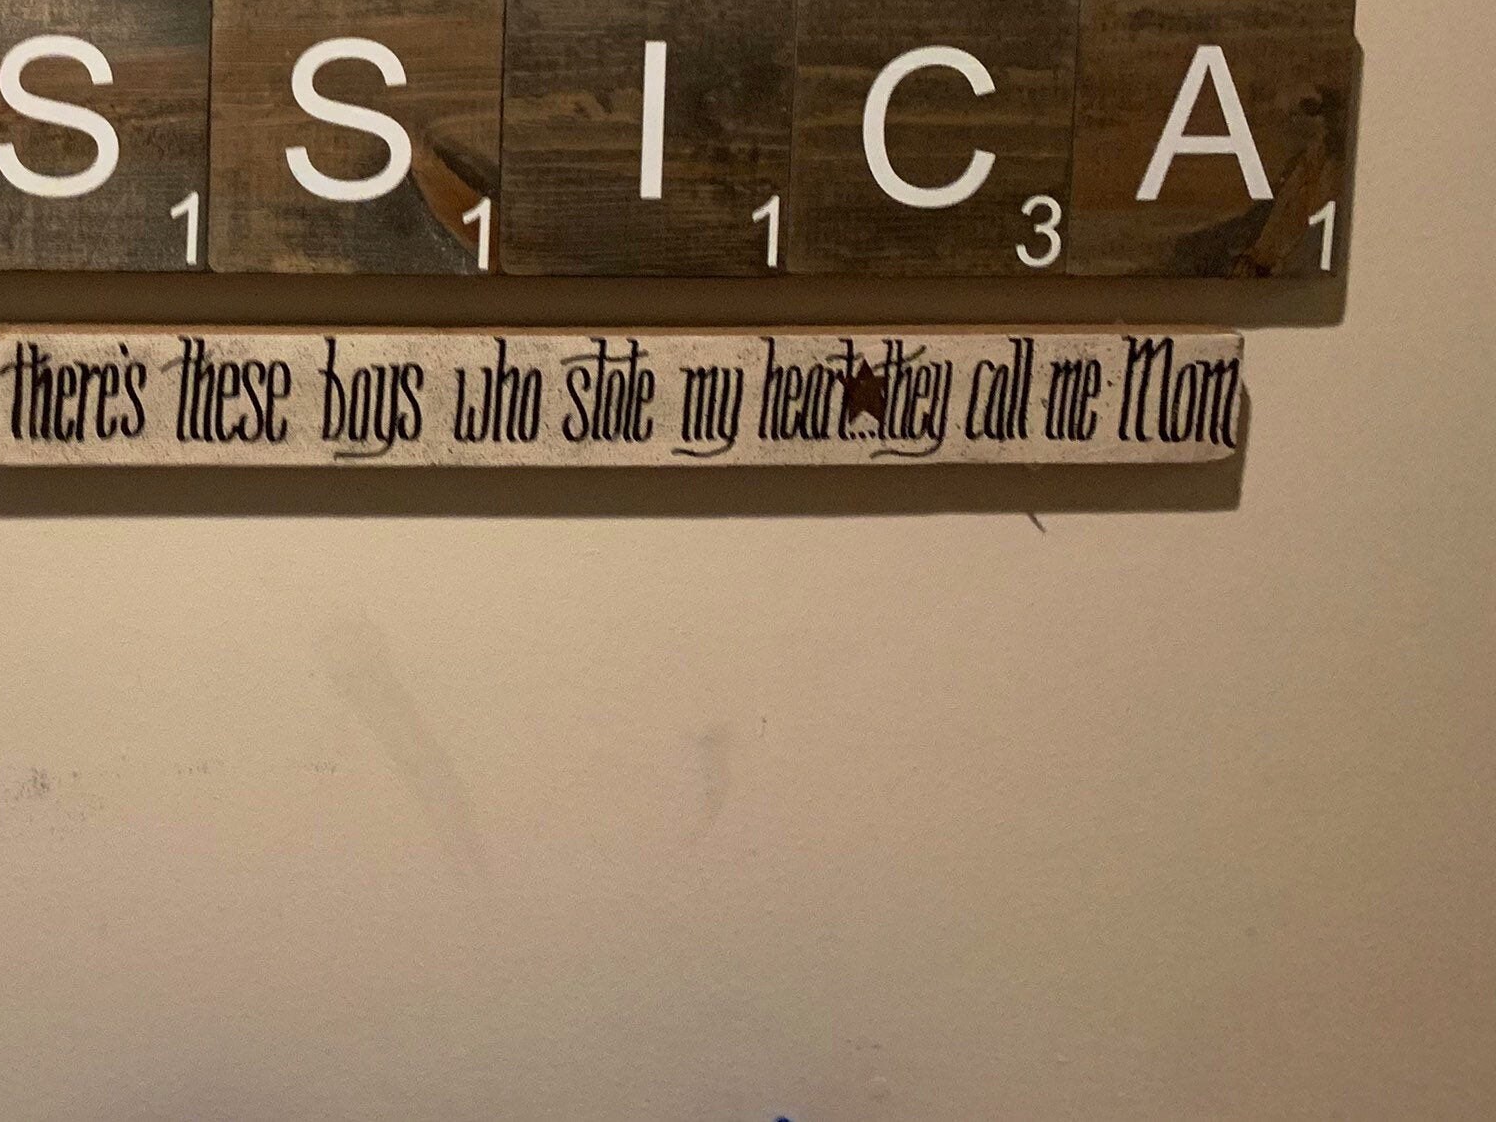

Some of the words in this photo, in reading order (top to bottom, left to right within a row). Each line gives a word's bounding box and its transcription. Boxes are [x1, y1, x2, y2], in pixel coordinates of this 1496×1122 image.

[169, 190, 200, 265] 1
[461, 197, 492, 268] 1
[751, 194, 781, 268] 1
[1015, 194, 1063, 268] 3
[1307, 200, 1336, 271] 1
[160, 336, 292, 443] these
[321, 337, 424, 460] boys
[454, 337, 543, 442] who
[560, 337, 655, 441] stole
[671, 365, 744, 456] my
[964, 337, 1034, 440] call
[1044, 358, 1101, 440] me
[1117, 336, 1241, 448] Mom
